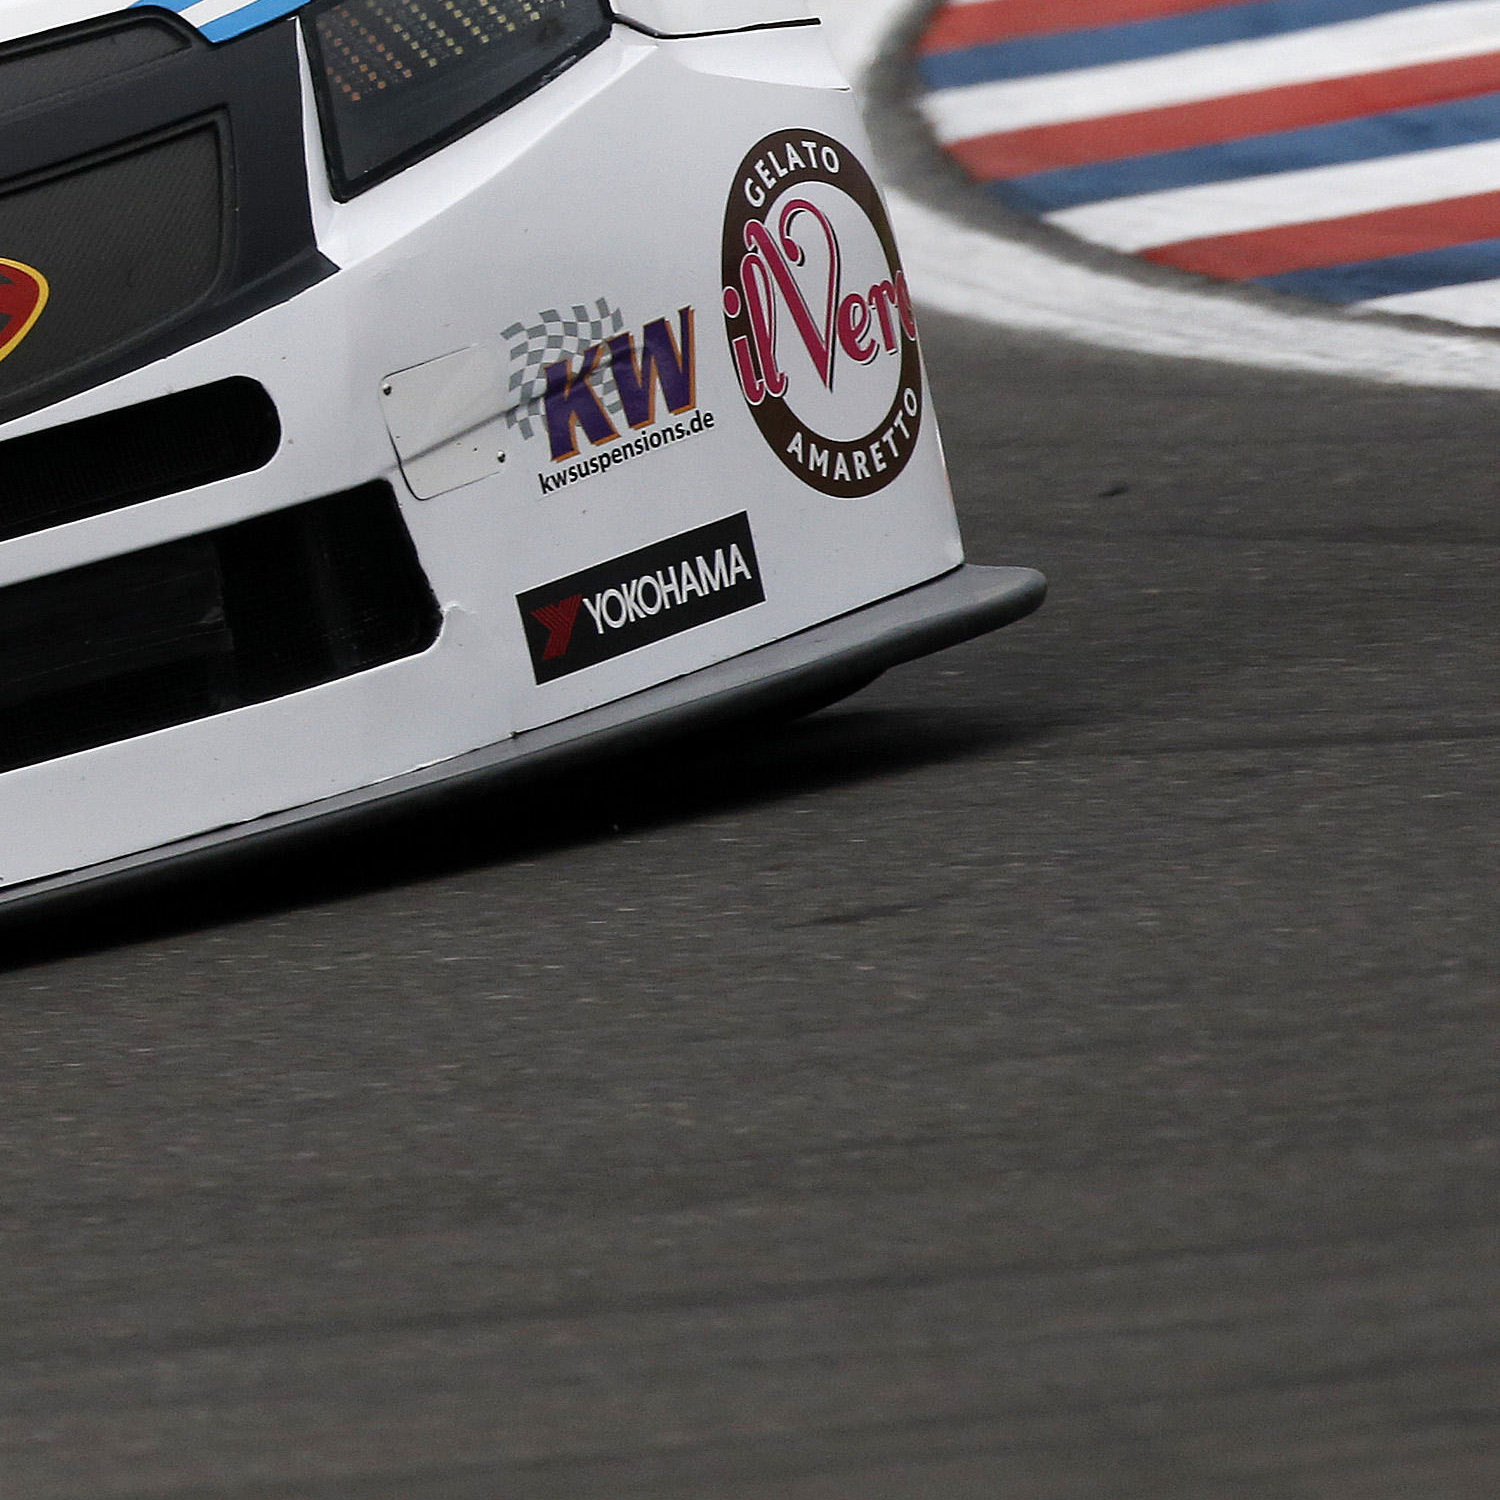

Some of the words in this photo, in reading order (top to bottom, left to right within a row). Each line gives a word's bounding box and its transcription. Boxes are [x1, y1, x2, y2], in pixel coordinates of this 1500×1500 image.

[743, 140, 841, 208] GELATO
[542, 304, 697, 464] KW
[538, 406, 716, 495] kwsuspensions.de
[786, 387, 918, 482] AMARETTO
[581, 542, 752, 635] YOKOHAMA
